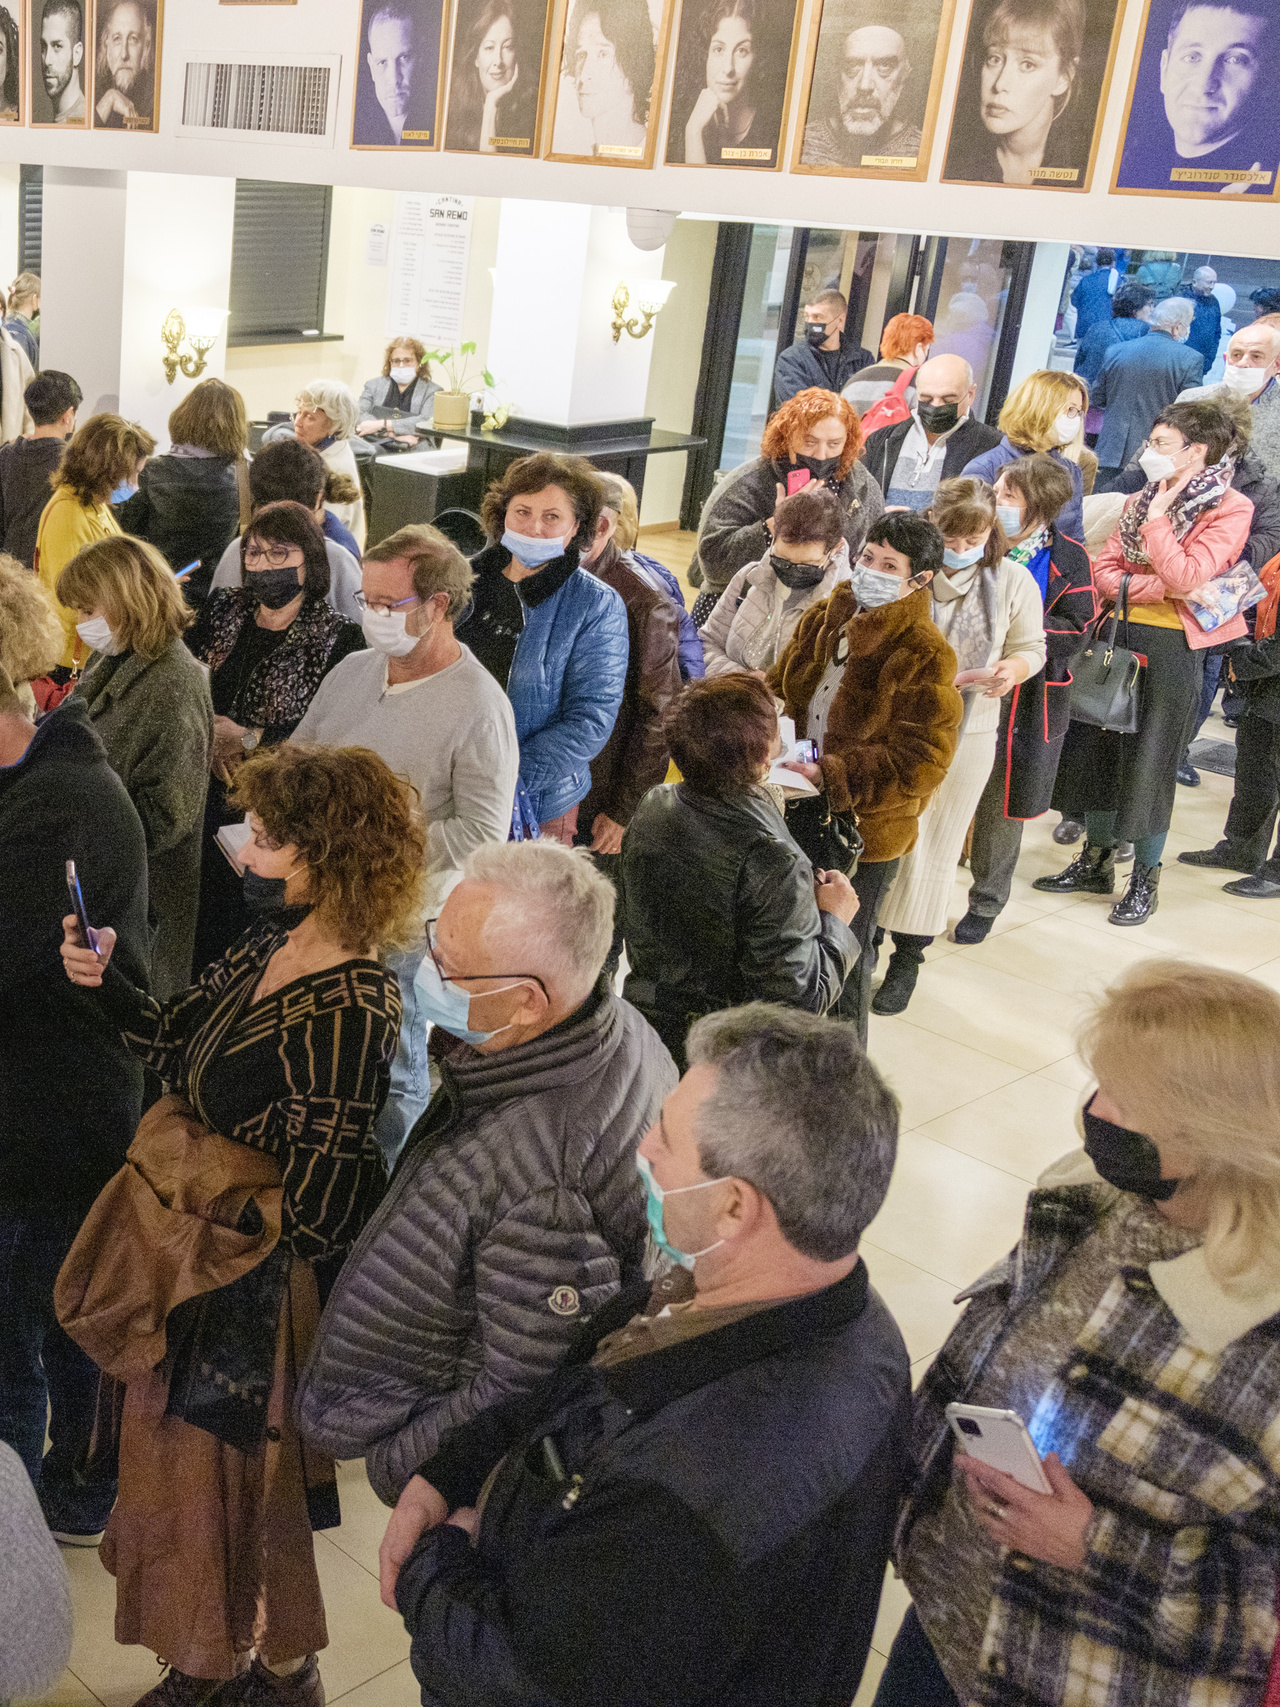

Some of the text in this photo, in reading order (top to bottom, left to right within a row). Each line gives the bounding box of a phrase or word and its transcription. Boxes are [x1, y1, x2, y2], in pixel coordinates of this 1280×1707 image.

[748, 150, 768, 158] אפרת
[1028, 169, 1073, 179] נטשה מנור
[1224, 172, 1266, 182] אלכסנדר
[429, 208, 468, 221] SAN REMO
